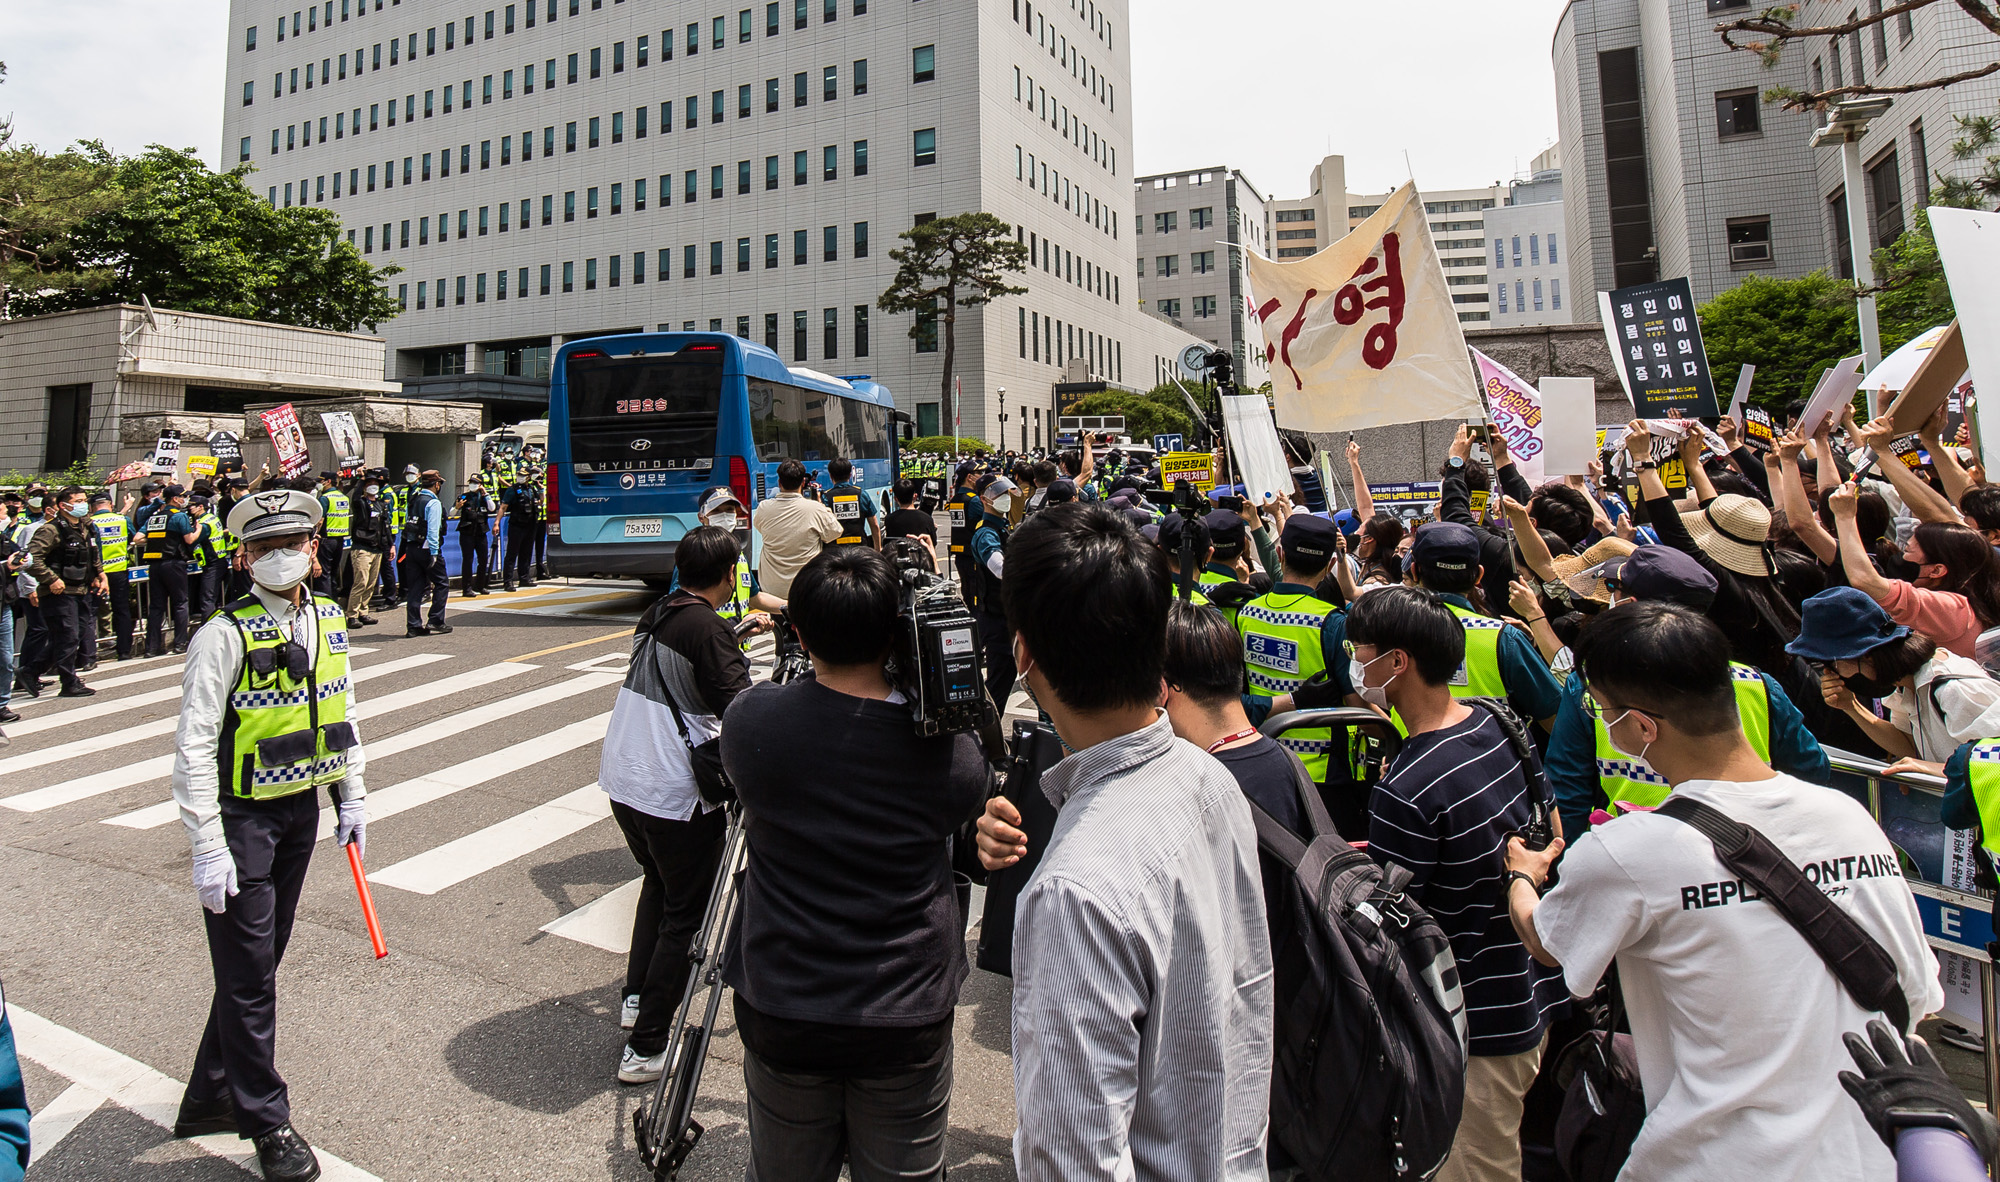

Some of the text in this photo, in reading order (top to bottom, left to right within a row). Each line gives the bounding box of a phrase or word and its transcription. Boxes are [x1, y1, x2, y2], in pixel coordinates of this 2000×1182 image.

[616, 398, 668, 414] 긴급호송
[599, 459, 687, 471] HYUNDAI
[1165, 459, 1208, 471] 입양모장씨
[638, 473, 666, 484] 법무부
[1437, 562, 1466, 570] POLICE
[1250, 653, 1293, 670] POLICE
[1681, 854, 1901, 911] REPL ONTAINE
[1821, 885, 1849, 897] ンテナ
